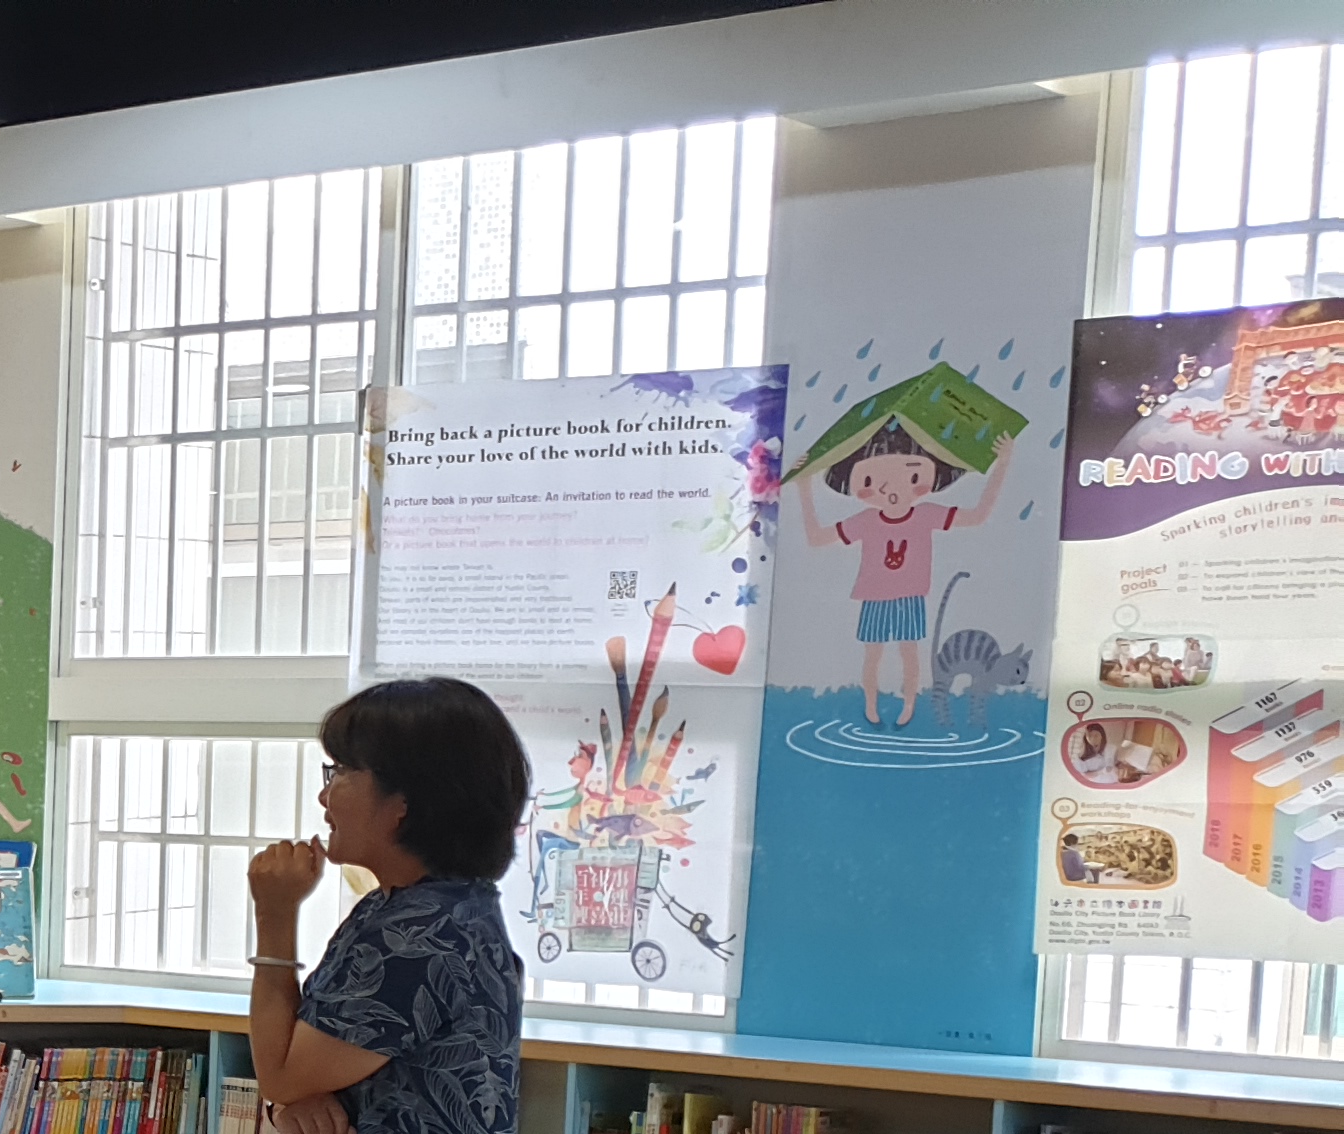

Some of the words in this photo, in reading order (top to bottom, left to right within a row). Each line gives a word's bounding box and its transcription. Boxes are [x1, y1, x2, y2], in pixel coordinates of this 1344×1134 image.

[388, 429, 435, 446] Bring
[440, 426, 479, 441] back
[483, 429, 493, 440] a
[498, 423, 562, 443] picture
[567, 420, 611, 436] book
[616, 418, 643, 434] for
[647, 416, 732, 432] children.
[386, 452, 433, 467] Share
[436, 452, 475, 469] your
[480, 448, 514, 463] love
[518, 446, 538, 461] of
[541, 446, 569, 461] the
[574, 443, 627, 459] world
[631, 441, 673, 456] with
[678, 440, 724, 455] kids.
[1079, 450, 1250, 488] READING
[1261, 448, 1344, 477] WITH
[383, 497, 391, 507] A
[394, 496, 428, 509] picture
[432, 496, 456, 506] book
[459, 495, 468, 505] in
[471, 496, 493, 508] your
[497, 493, 541, 505] suitcase:
[545, 492, 559, 503] An
[562, 491, 611, 502] invitation
[615, 490, 626, 501] to
[629, 490, 653, 501] read
[657, 489, 675, 500] the
[678, 488, 711, 499] world.
[1160, 511, 1227, 542] Sparking
[1234, 496, 1314, 520] children's
[1120, 563, 1168, 580] Project
[1120, 578, 1158, 594] goals
[1254, 692, 1278, 709] 1167
[1274, 721, 1297, 739] 1137
[1294, 750, 1316, 765] 976
[1311, 779, 1333, 796] 559
[1209, 818, 1221, 849] 2018
[1230, 833, 1243, 863] 2017
[1250, 843, 1263, 874] 2016
[1271, 855, 1285, 886] 2015
[1292, 867, 1304, 898] 2014
[1312, 879, 1326, 910] 2013
